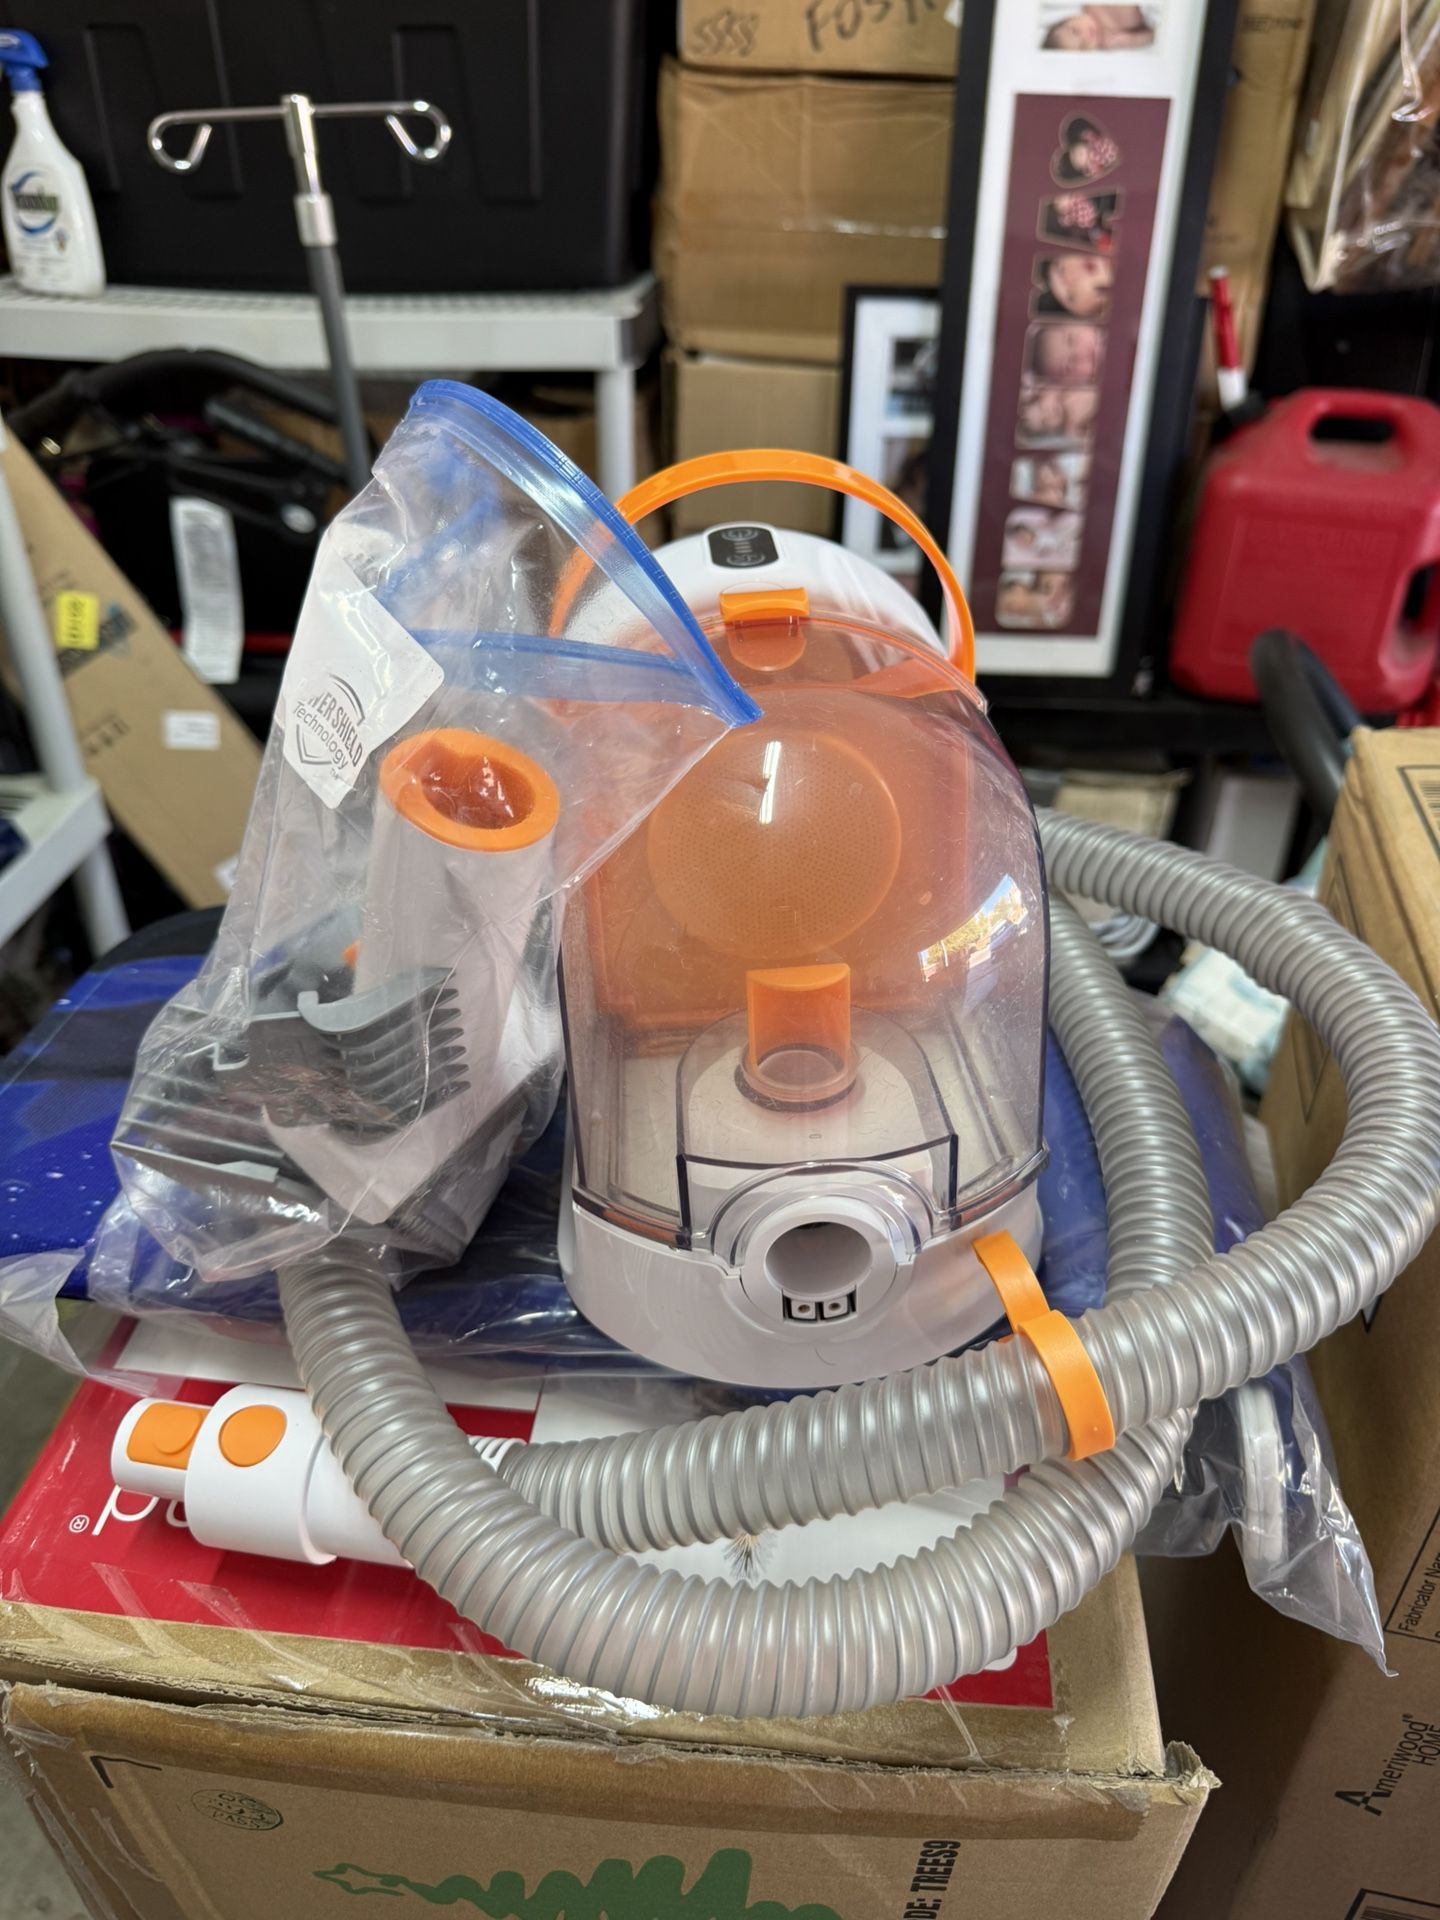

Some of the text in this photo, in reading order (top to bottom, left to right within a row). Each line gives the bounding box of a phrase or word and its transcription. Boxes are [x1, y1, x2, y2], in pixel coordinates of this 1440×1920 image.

[293, 700, 349, 770] Technology
[1398, 1579, 1437, 1632] Fabricator
[910, 1840, 962, 1893] TREES9
